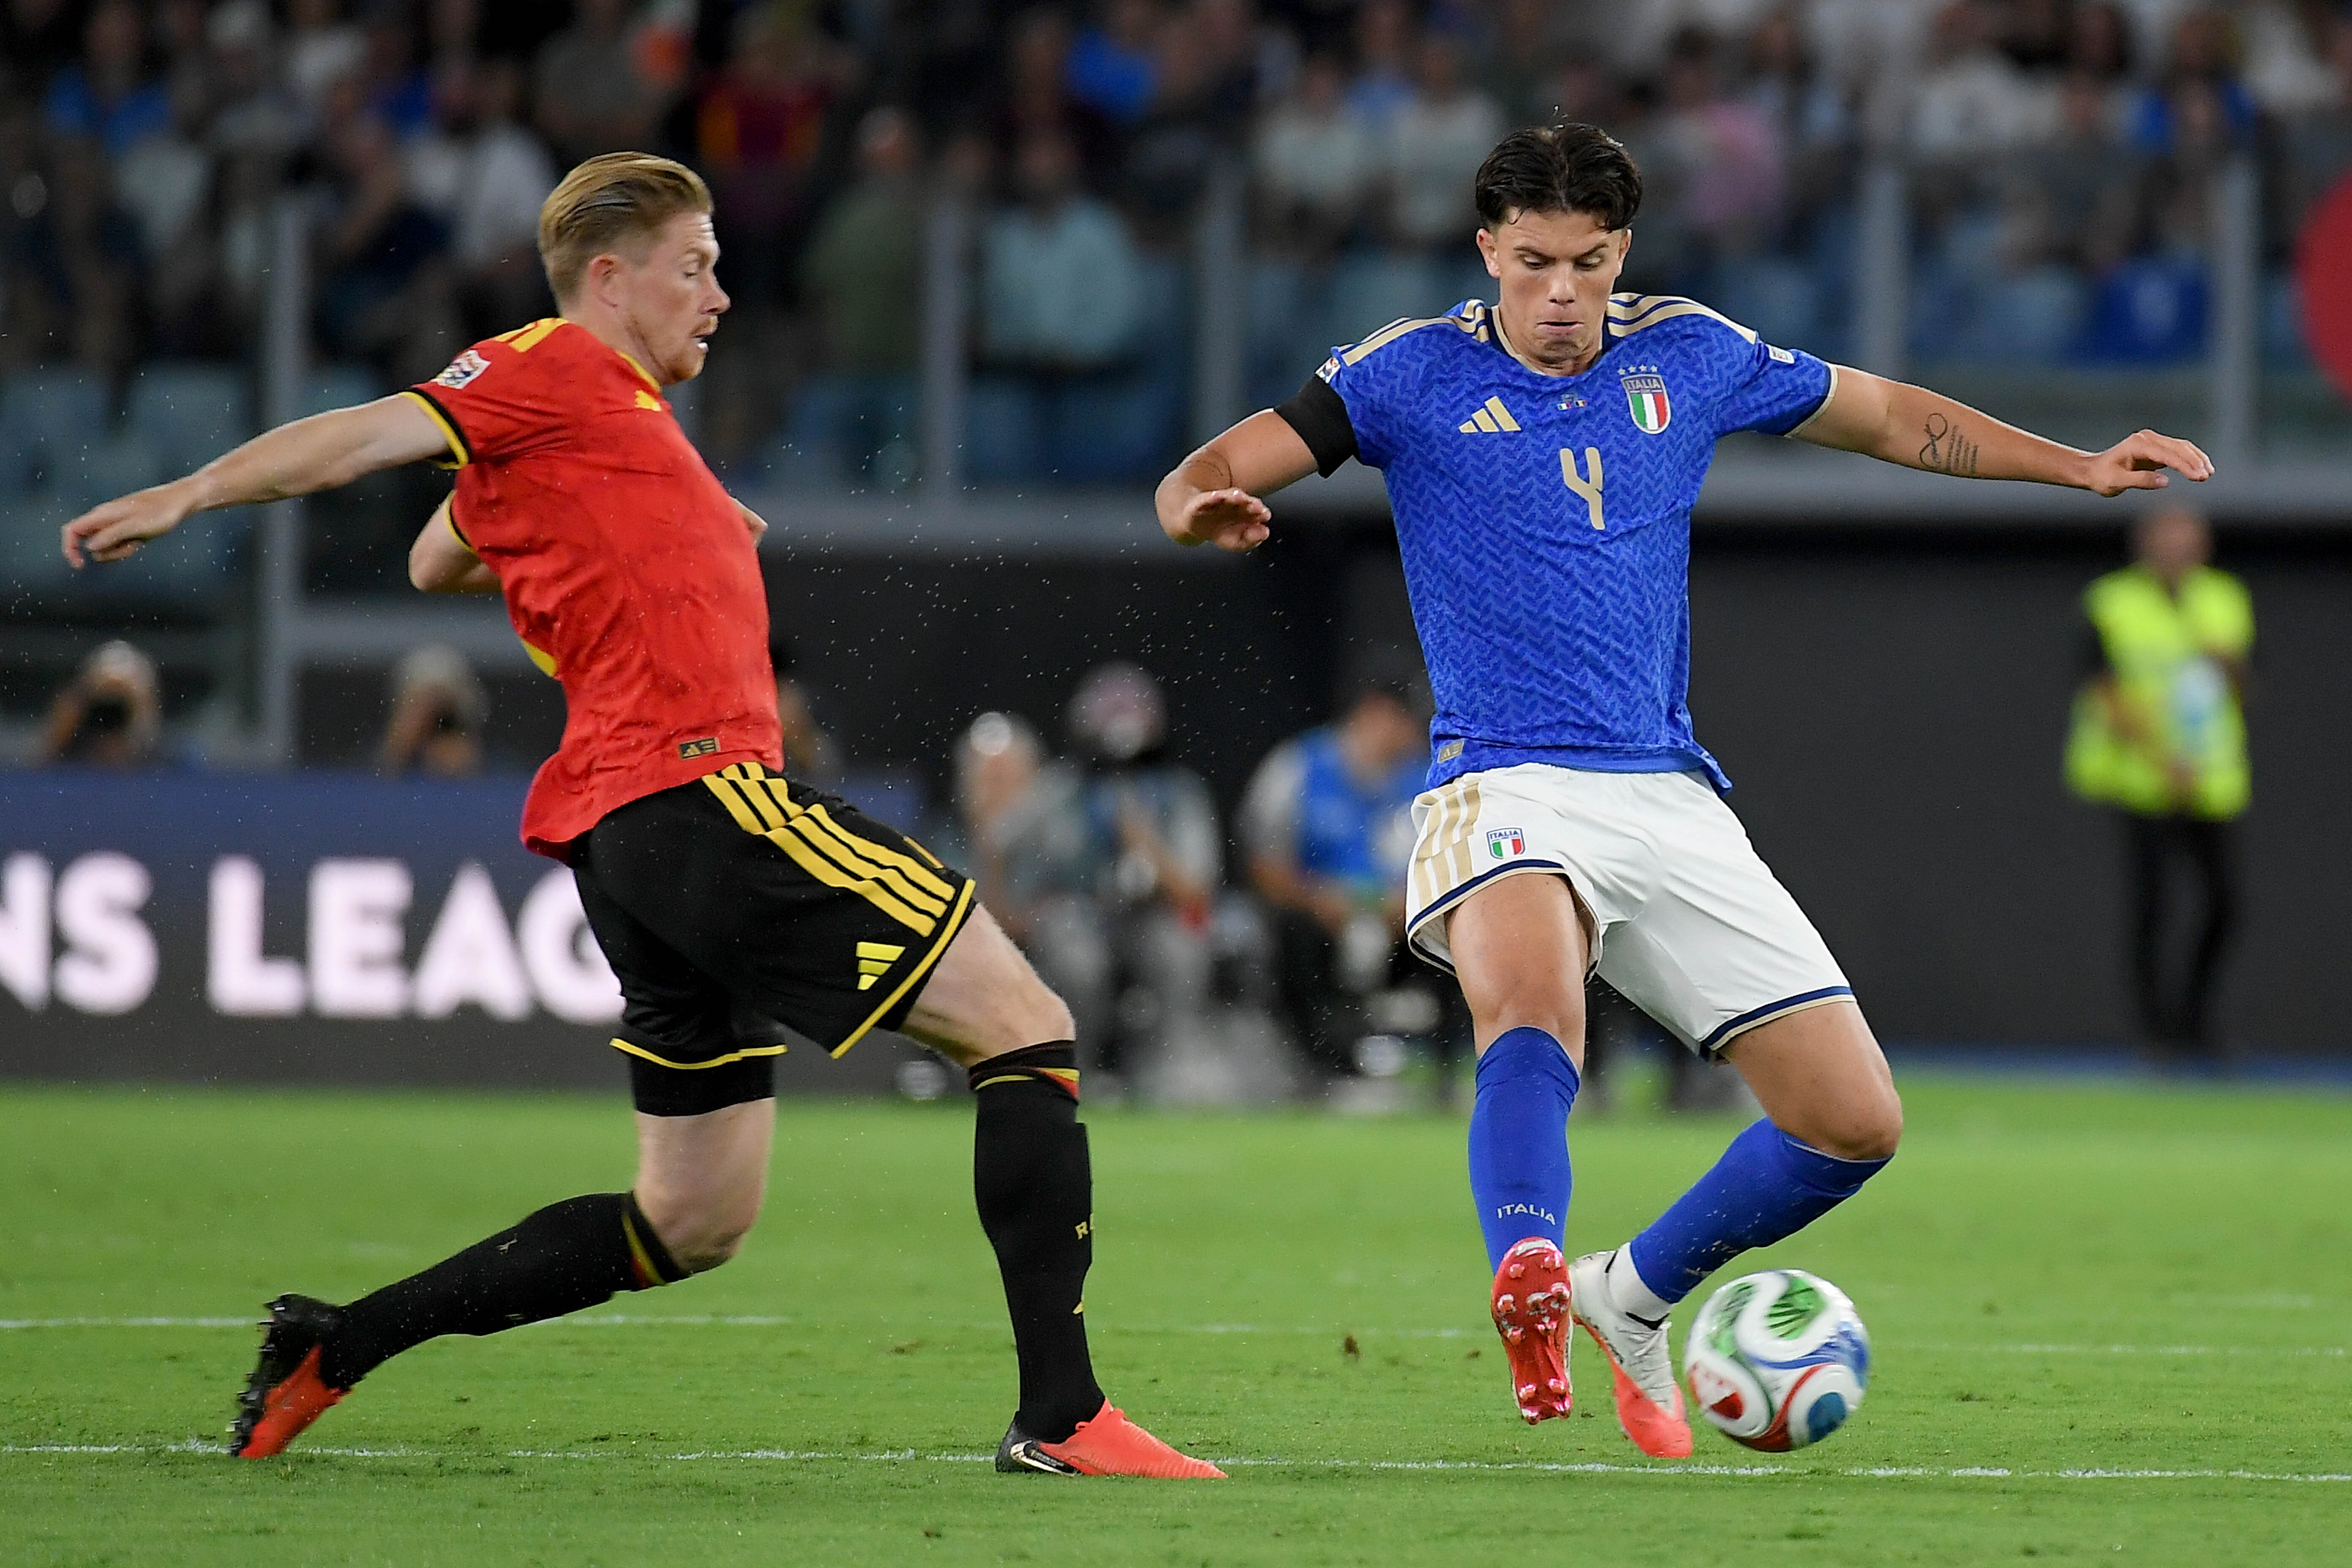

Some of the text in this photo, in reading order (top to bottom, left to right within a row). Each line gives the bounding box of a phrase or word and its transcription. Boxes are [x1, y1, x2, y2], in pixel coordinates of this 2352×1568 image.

[1624, 378, 1661, 390] ITALIA
[1560, 446, 1605, 530] 4
[1489, 830, 1519, 840] ITALIA
[1497, 1203, 1556, 1225] ITALIA
